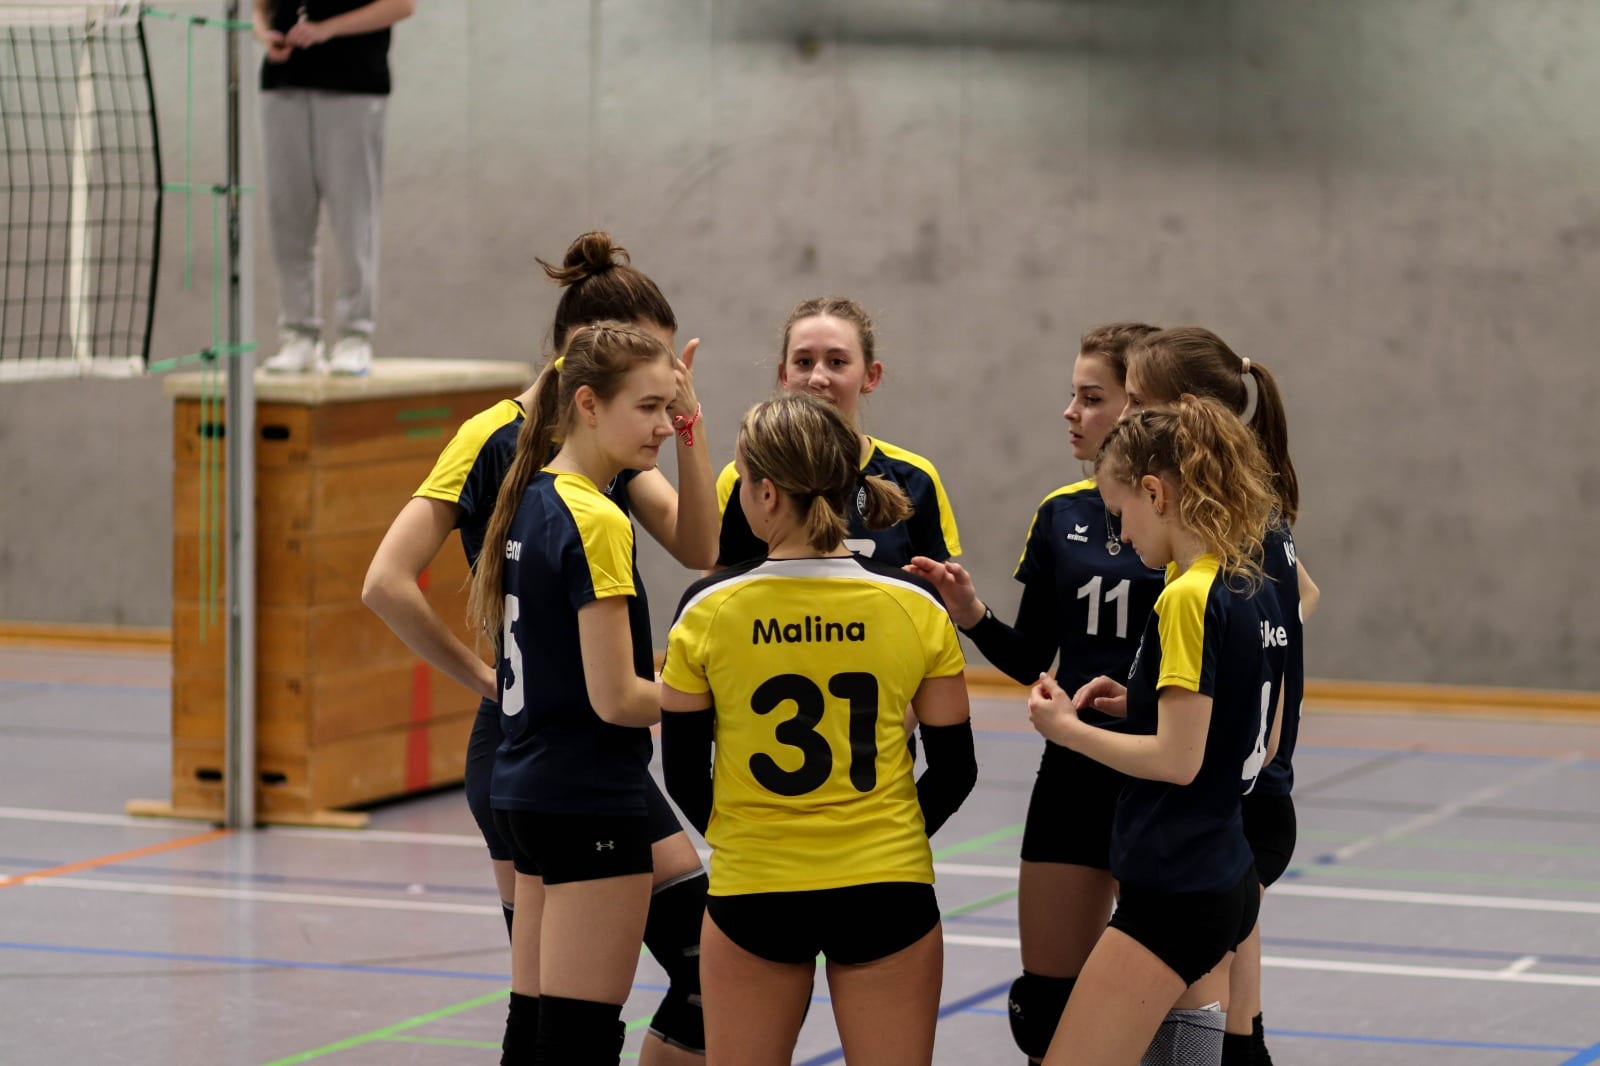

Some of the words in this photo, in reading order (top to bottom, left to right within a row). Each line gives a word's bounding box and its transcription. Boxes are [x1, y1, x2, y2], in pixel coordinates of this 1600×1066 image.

[752, 615, 865, 645] Malina
[1077, 575, 1131, 639] 11
[749, 671, 879, 797] 31
